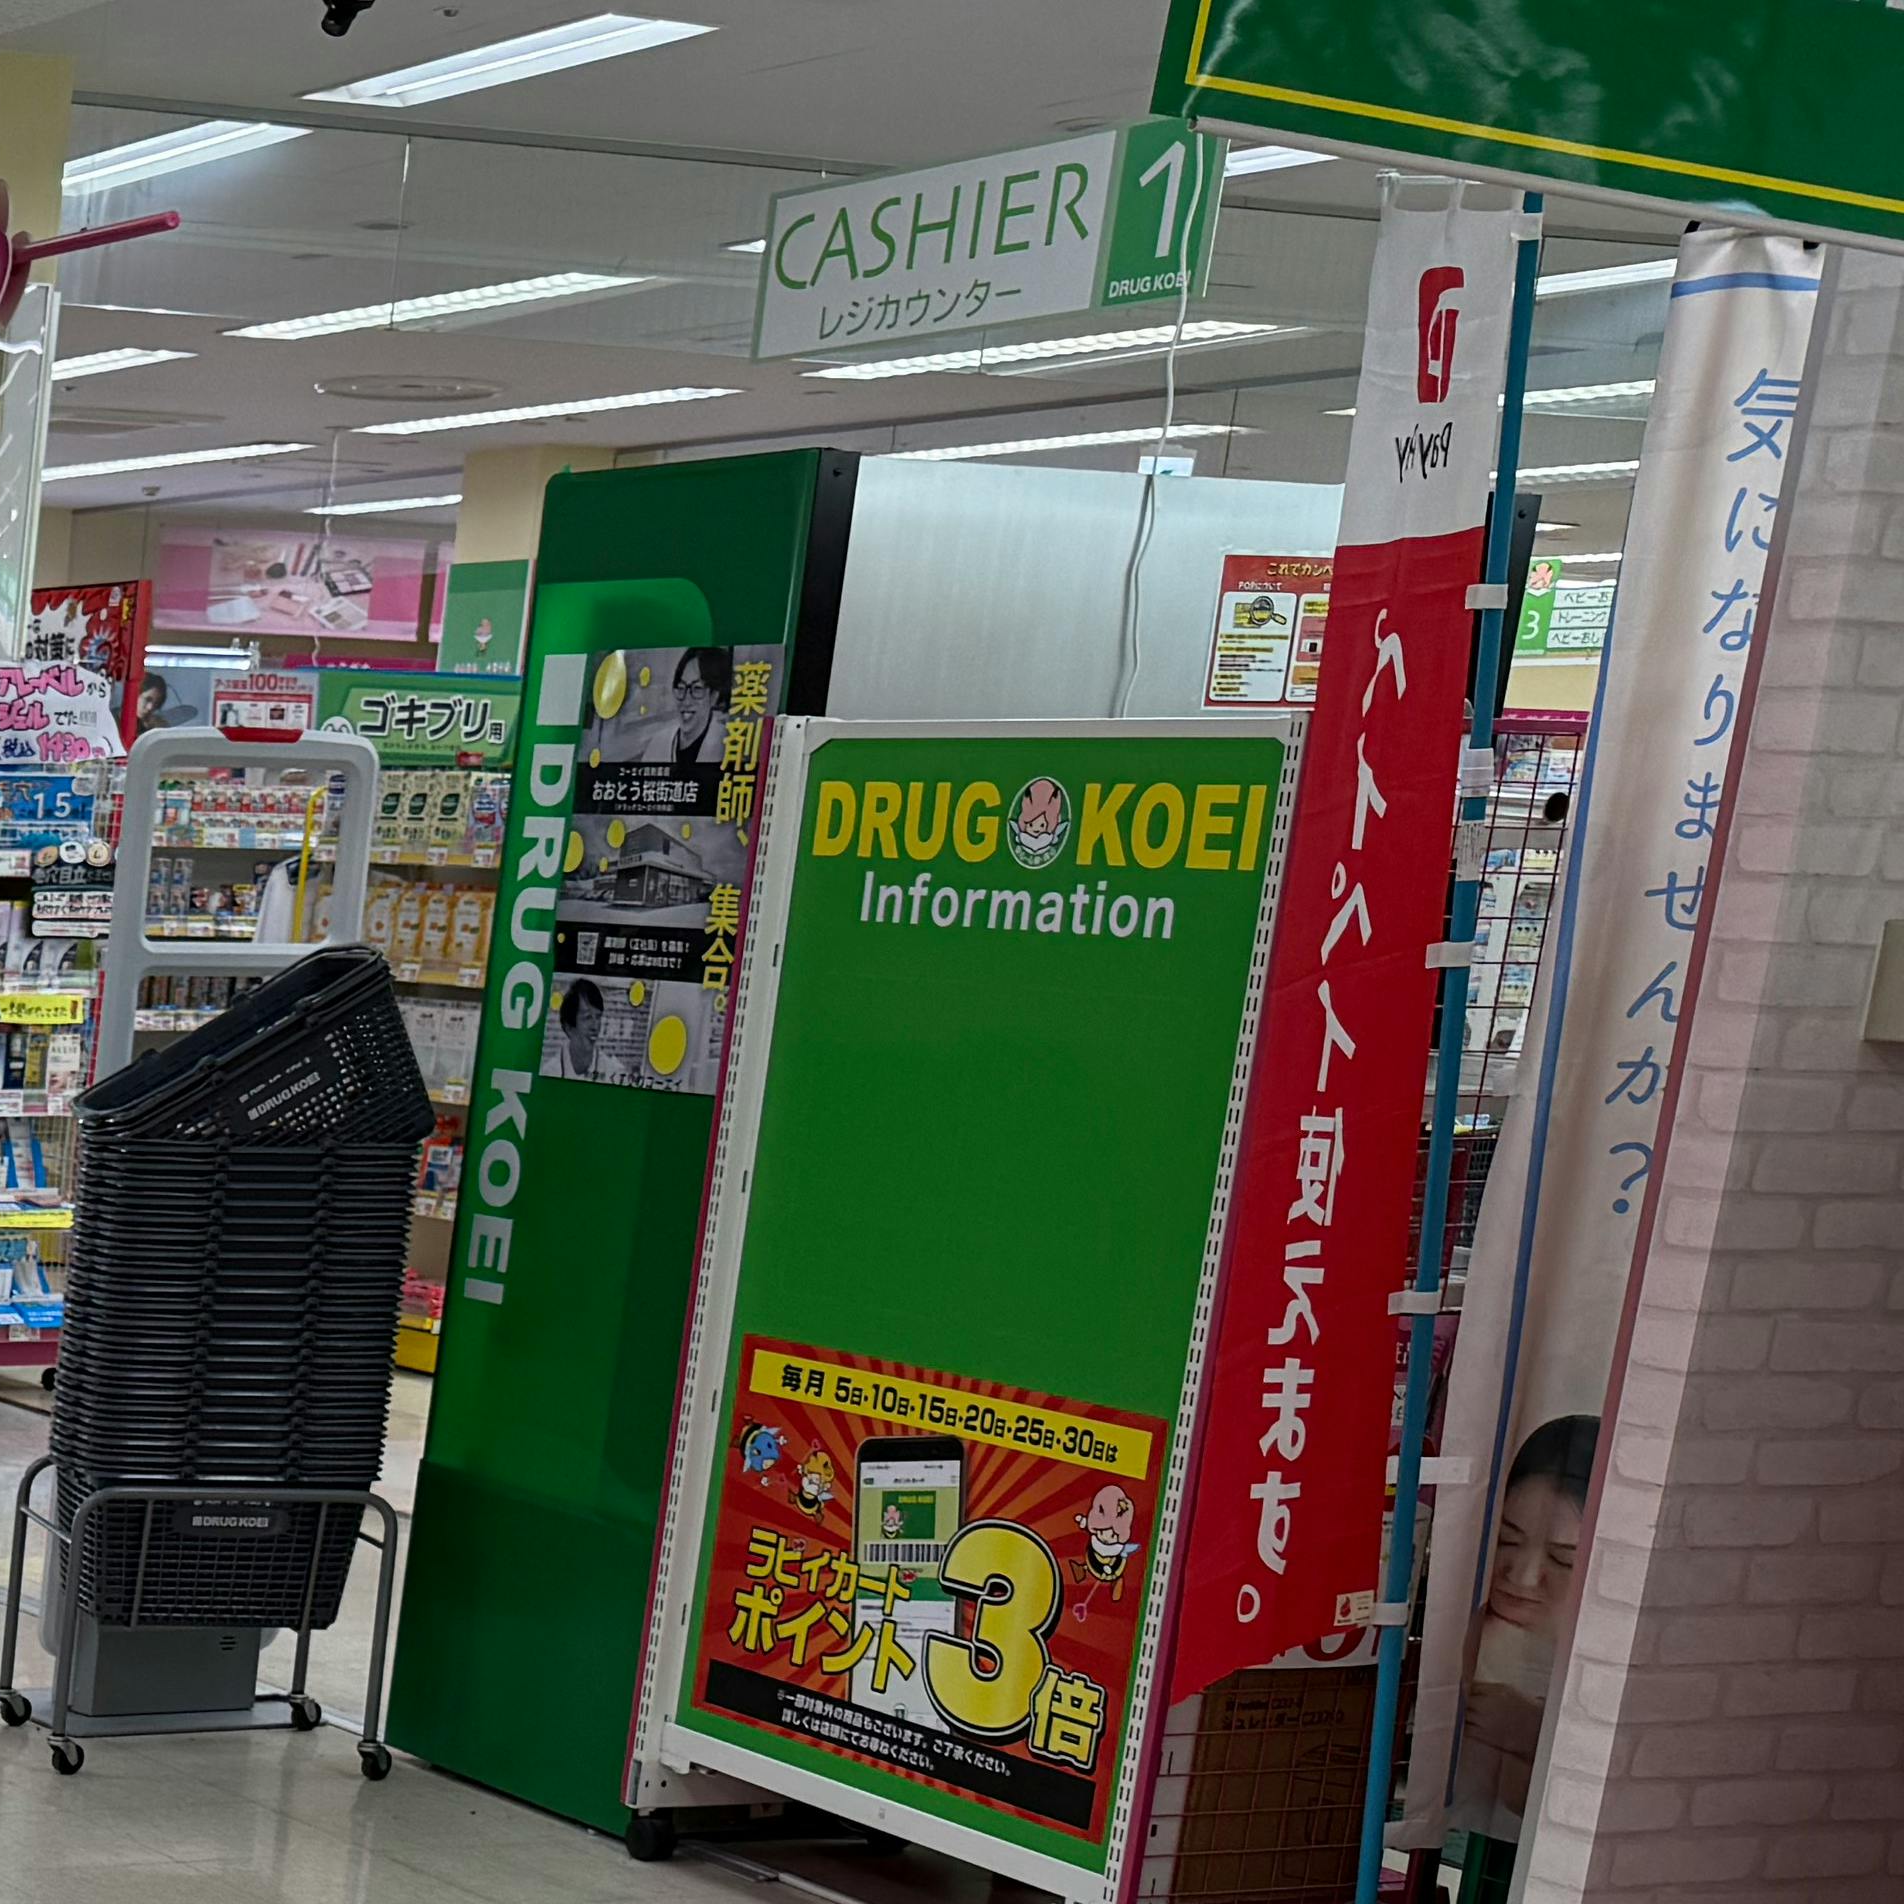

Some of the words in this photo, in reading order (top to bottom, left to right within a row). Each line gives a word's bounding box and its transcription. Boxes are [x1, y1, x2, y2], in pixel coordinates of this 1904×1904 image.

[775, 162, 1089, 290] CASHIER
[819, 278, 1021, 340] レジカウンター
[1109, 276, 1151, 298] DRUG
[1521, 610, 1540, 640] 3
[358, 694, 506, 745] ゴキブリ用
[812, 780, 1003, 863] DRUG
[1075, 782, 1268, 871] KOEI
[1605, 366, 1804, 1216] 気になりませんか?
[501, 742, 576, 1031] DRUG
[860, 870, 1176, 940] Information
[464, 1068, 532, 1305] KOEI
[781, 1363, 825, 1398] 毎月
[203, 1516, 237, 1527] DRUG
[728, 1584, 917, 1695] ポイント
[922, 1518, 1065, 1744] 3
[1028, 1661, 1108, 1773] 倍
